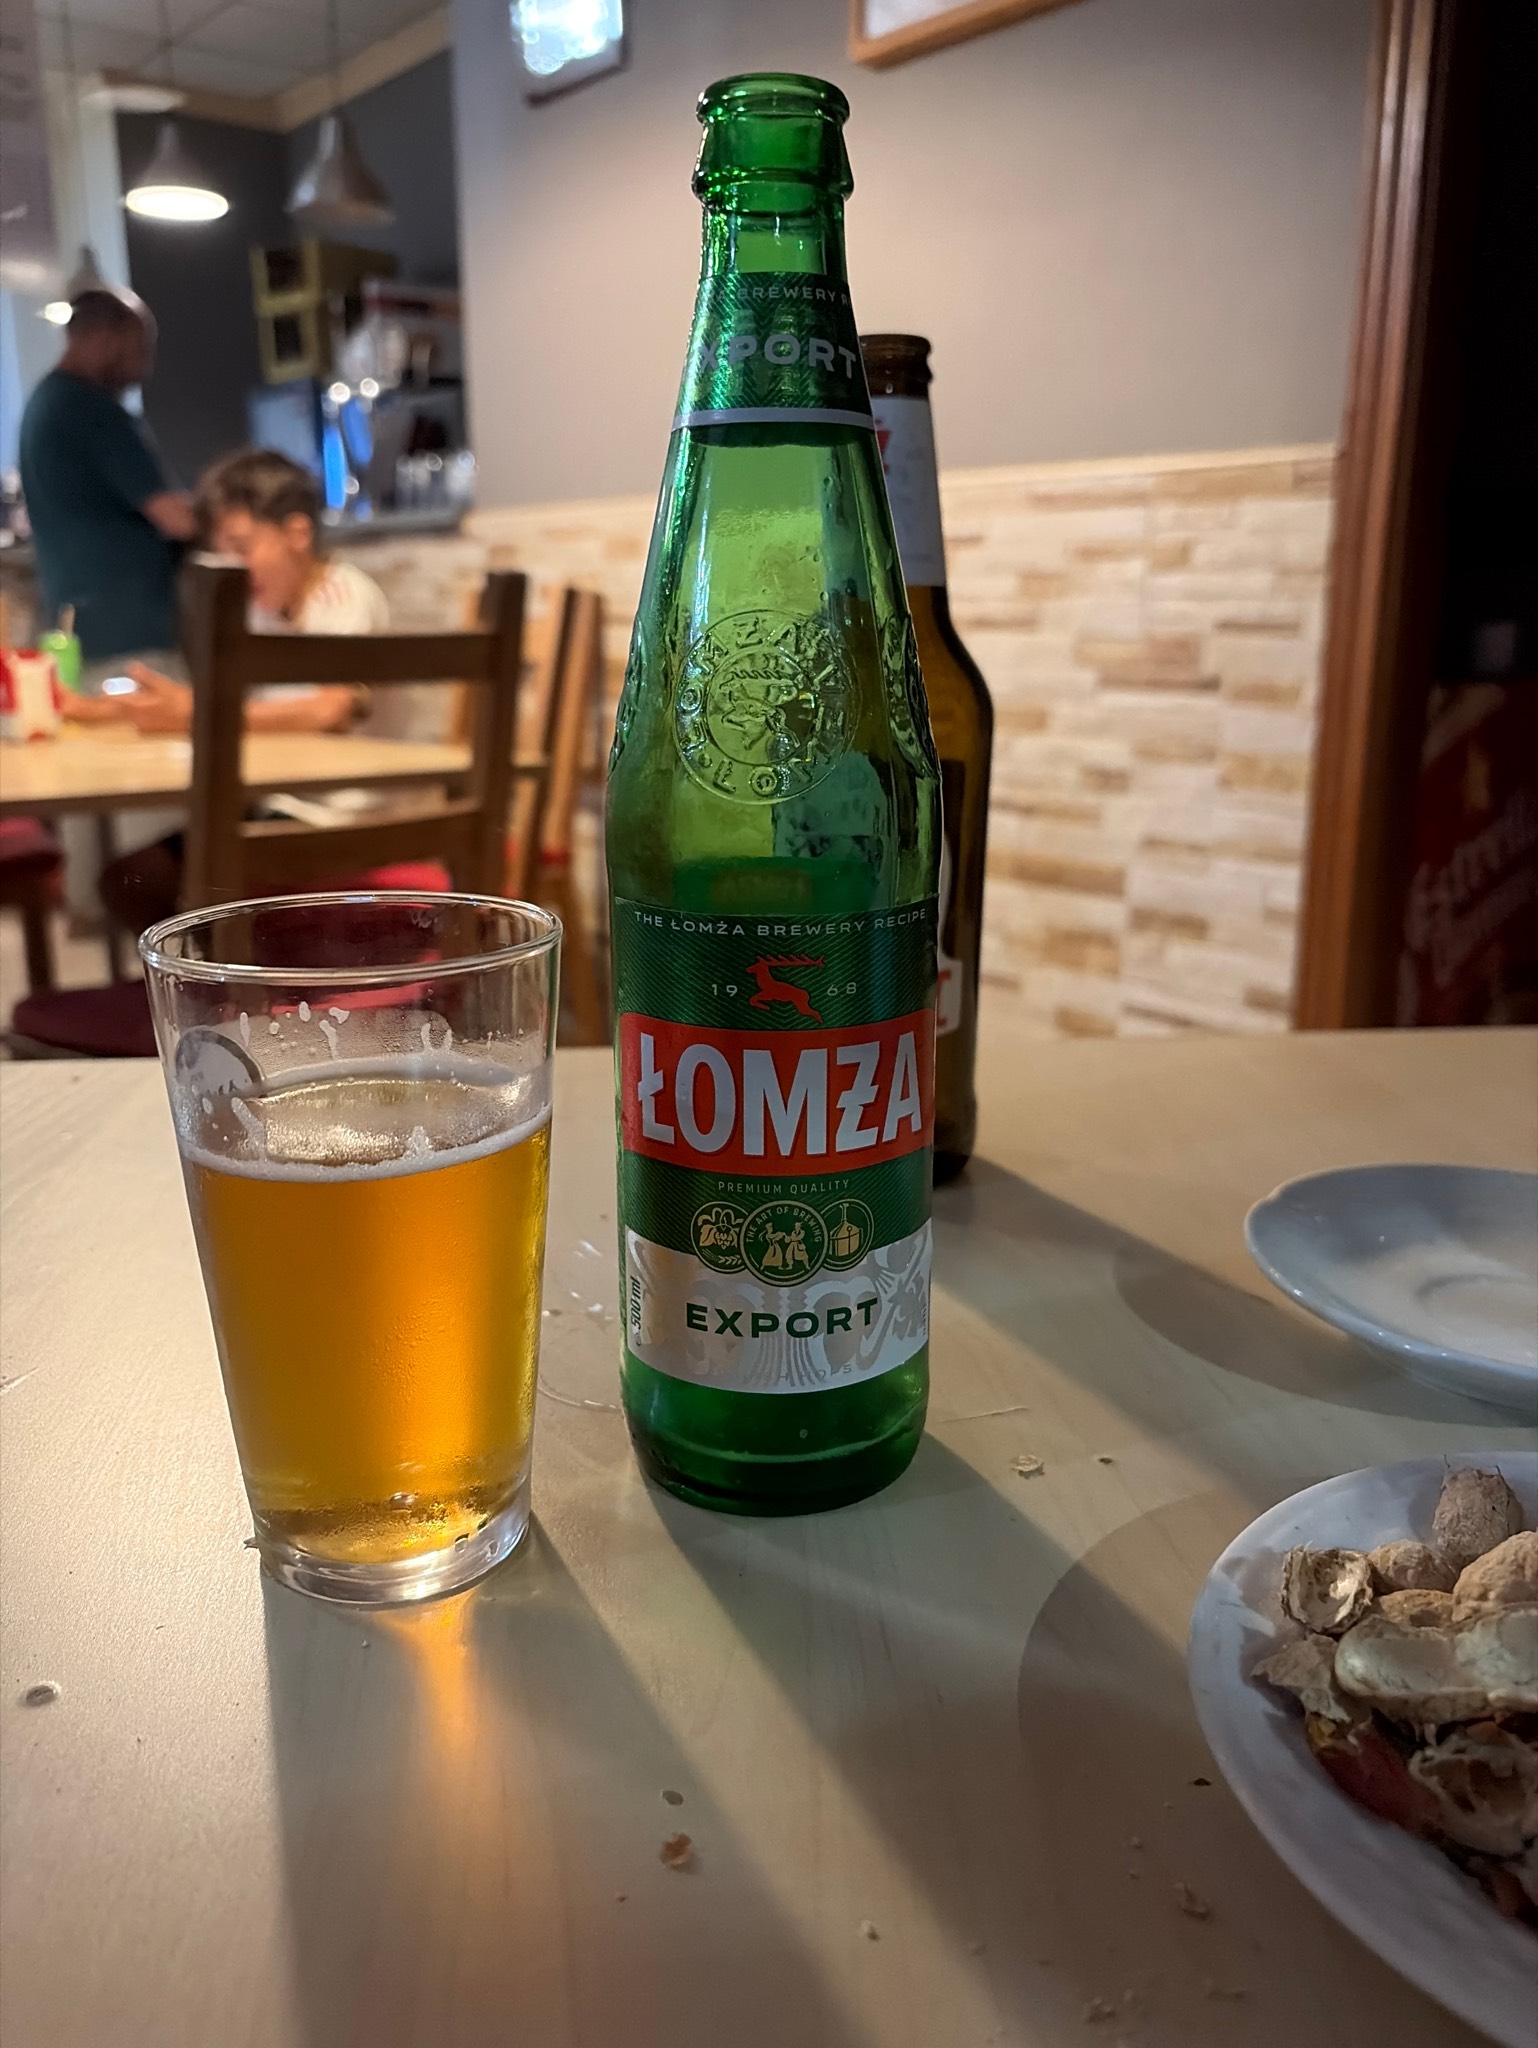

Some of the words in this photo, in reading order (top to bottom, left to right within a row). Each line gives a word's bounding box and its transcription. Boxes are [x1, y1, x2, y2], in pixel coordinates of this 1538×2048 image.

[736, 285, 837, 302] BREWERY
[698, 333, 857, 379] XPORT
[634, 911, 664, 928] THE
[670, 918, 746, 936] ŁOMŻA
[756, 919, 866, 936] BREWERY
[874, 907, 927, 930] RECIPE
[717, 1180, 782, 1195] PREMIUM
[789, 1178, 850, 1195] QUALITY
[745, 1224, 758, 1243] THE
[755, 1209, 773, 1225] ART
[775, 1206, 790, 1215] OF
[792, 1207, 823, 1243] BREWING
[685, 1297, 878, 1339] EXPORT
